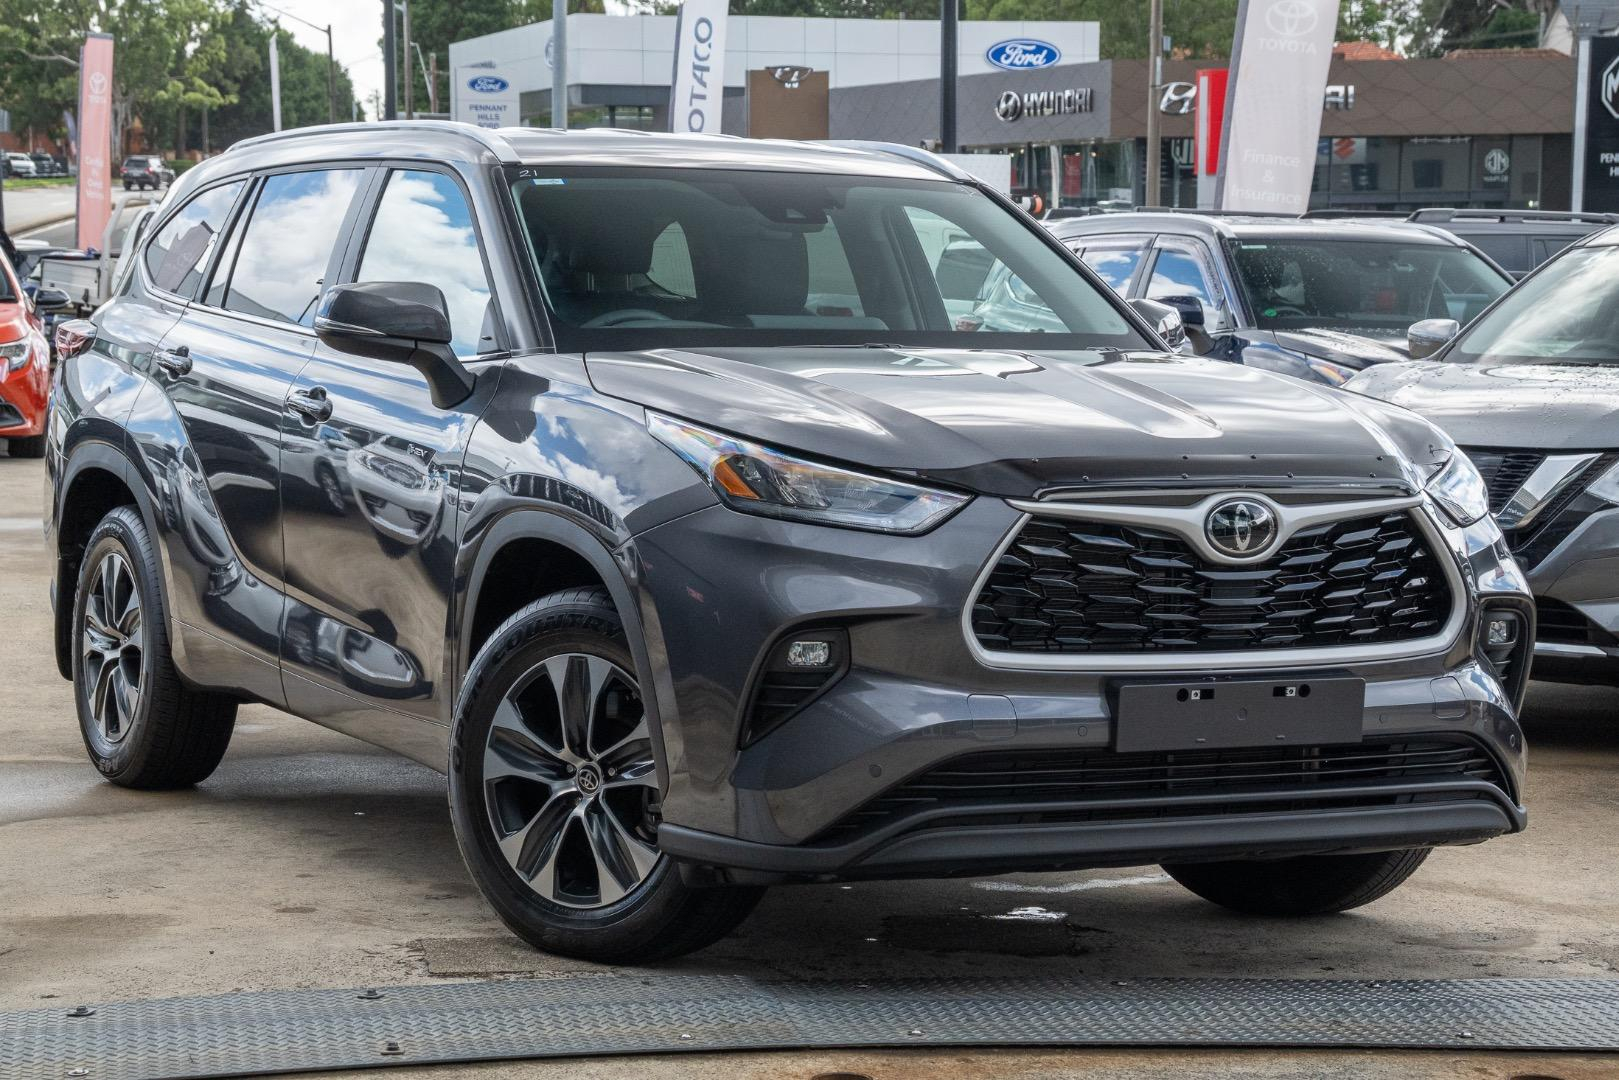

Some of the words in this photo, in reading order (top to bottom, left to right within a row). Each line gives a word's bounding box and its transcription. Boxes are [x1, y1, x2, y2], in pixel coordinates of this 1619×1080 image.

[1000, 42, 1048, 66] Ford
[1259, 38, 1317, 54] TOYOTA
[469, 104, 507, 112] PENNANT
[1024, 88, 1093, 116] HYUNDAI
[477, 113, 500, 121] HILLS
[1242, 149, 1301, 168] Finance
[1231, 185, 1303, 206] Insurance
